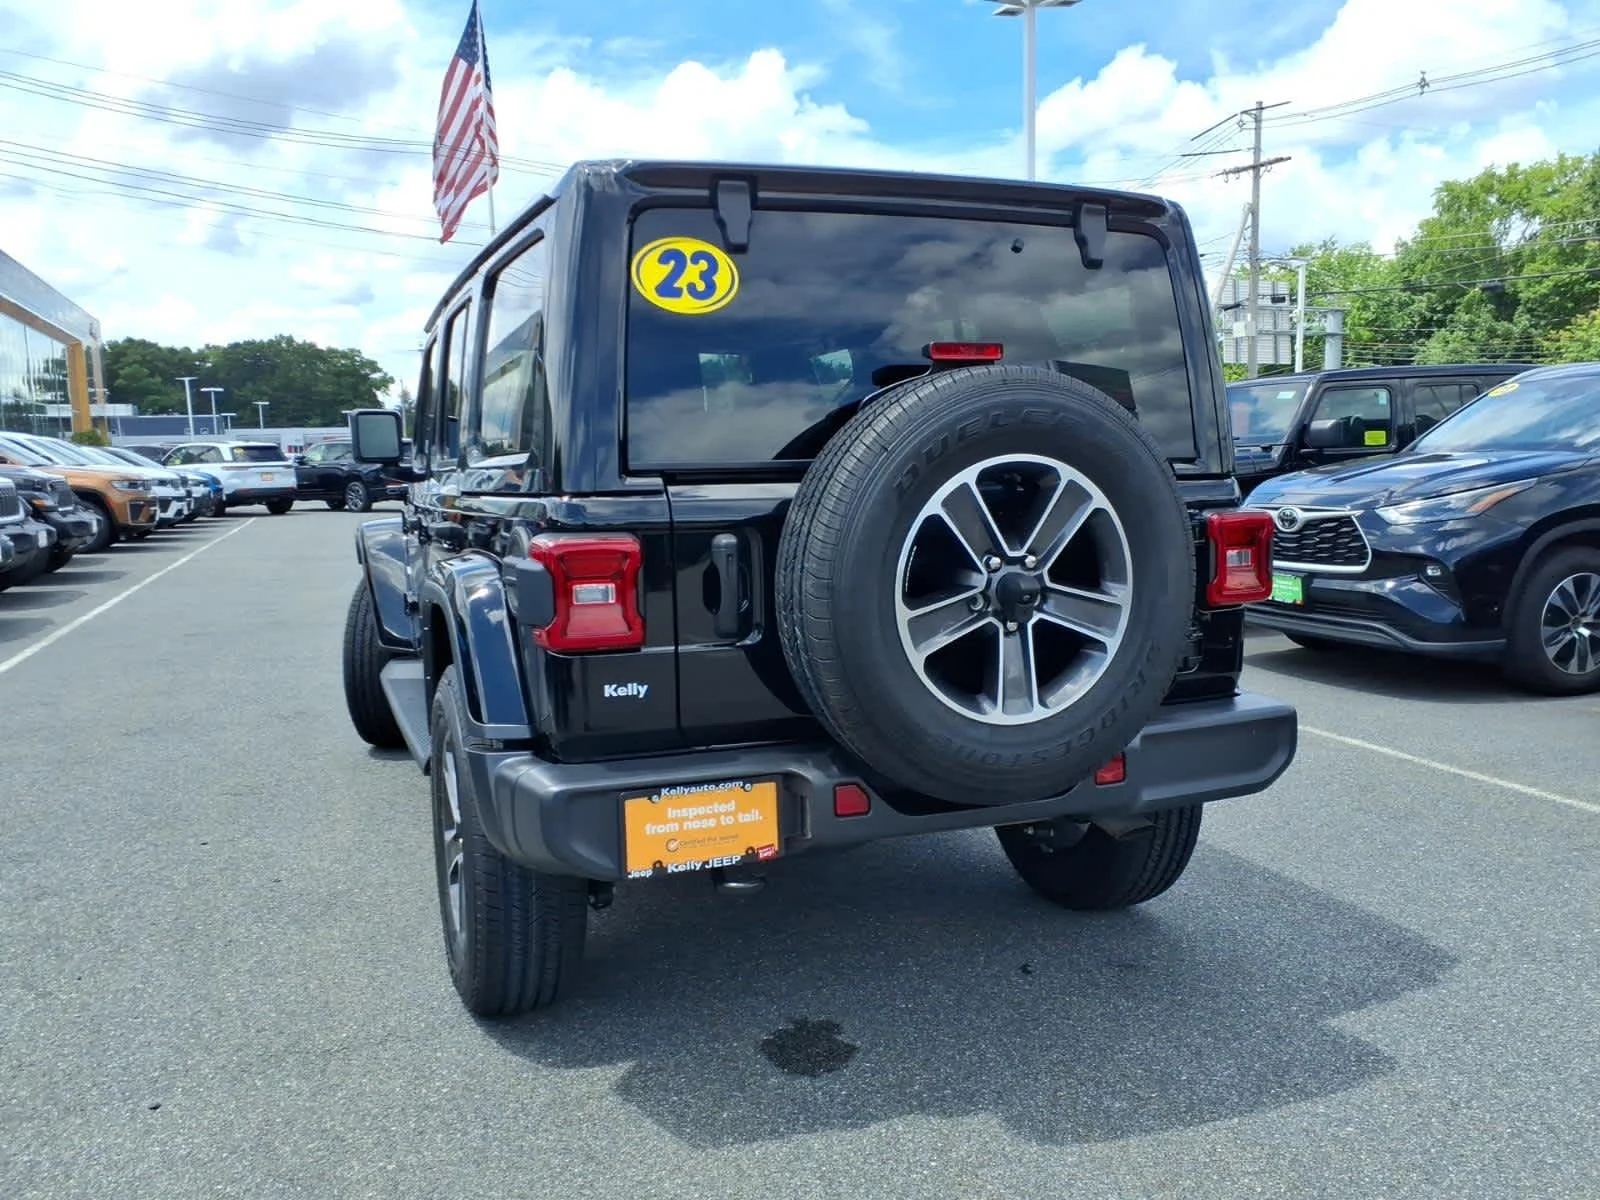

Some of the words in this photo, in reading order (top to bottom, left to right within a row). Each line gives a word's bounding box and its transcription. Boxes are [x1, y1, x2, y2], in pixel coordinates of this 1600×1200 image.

[655, 249, 719, 300] 23
[604, 683, 648, 699] Kelly
[660, 780, 744, 798] Kellyauto.com
[667, 800, 736, 820] Inspected
[645, 822, 679, 835] from
[683, 818, 717, 831] nose
[720, 814, 735, 826] to
[738, 809, 763, 823] tail.
[667, 860, 702, 873] Kelly
[705, 855, 742, 869] JEEP
[628, 868, 653, 879] Jeep
